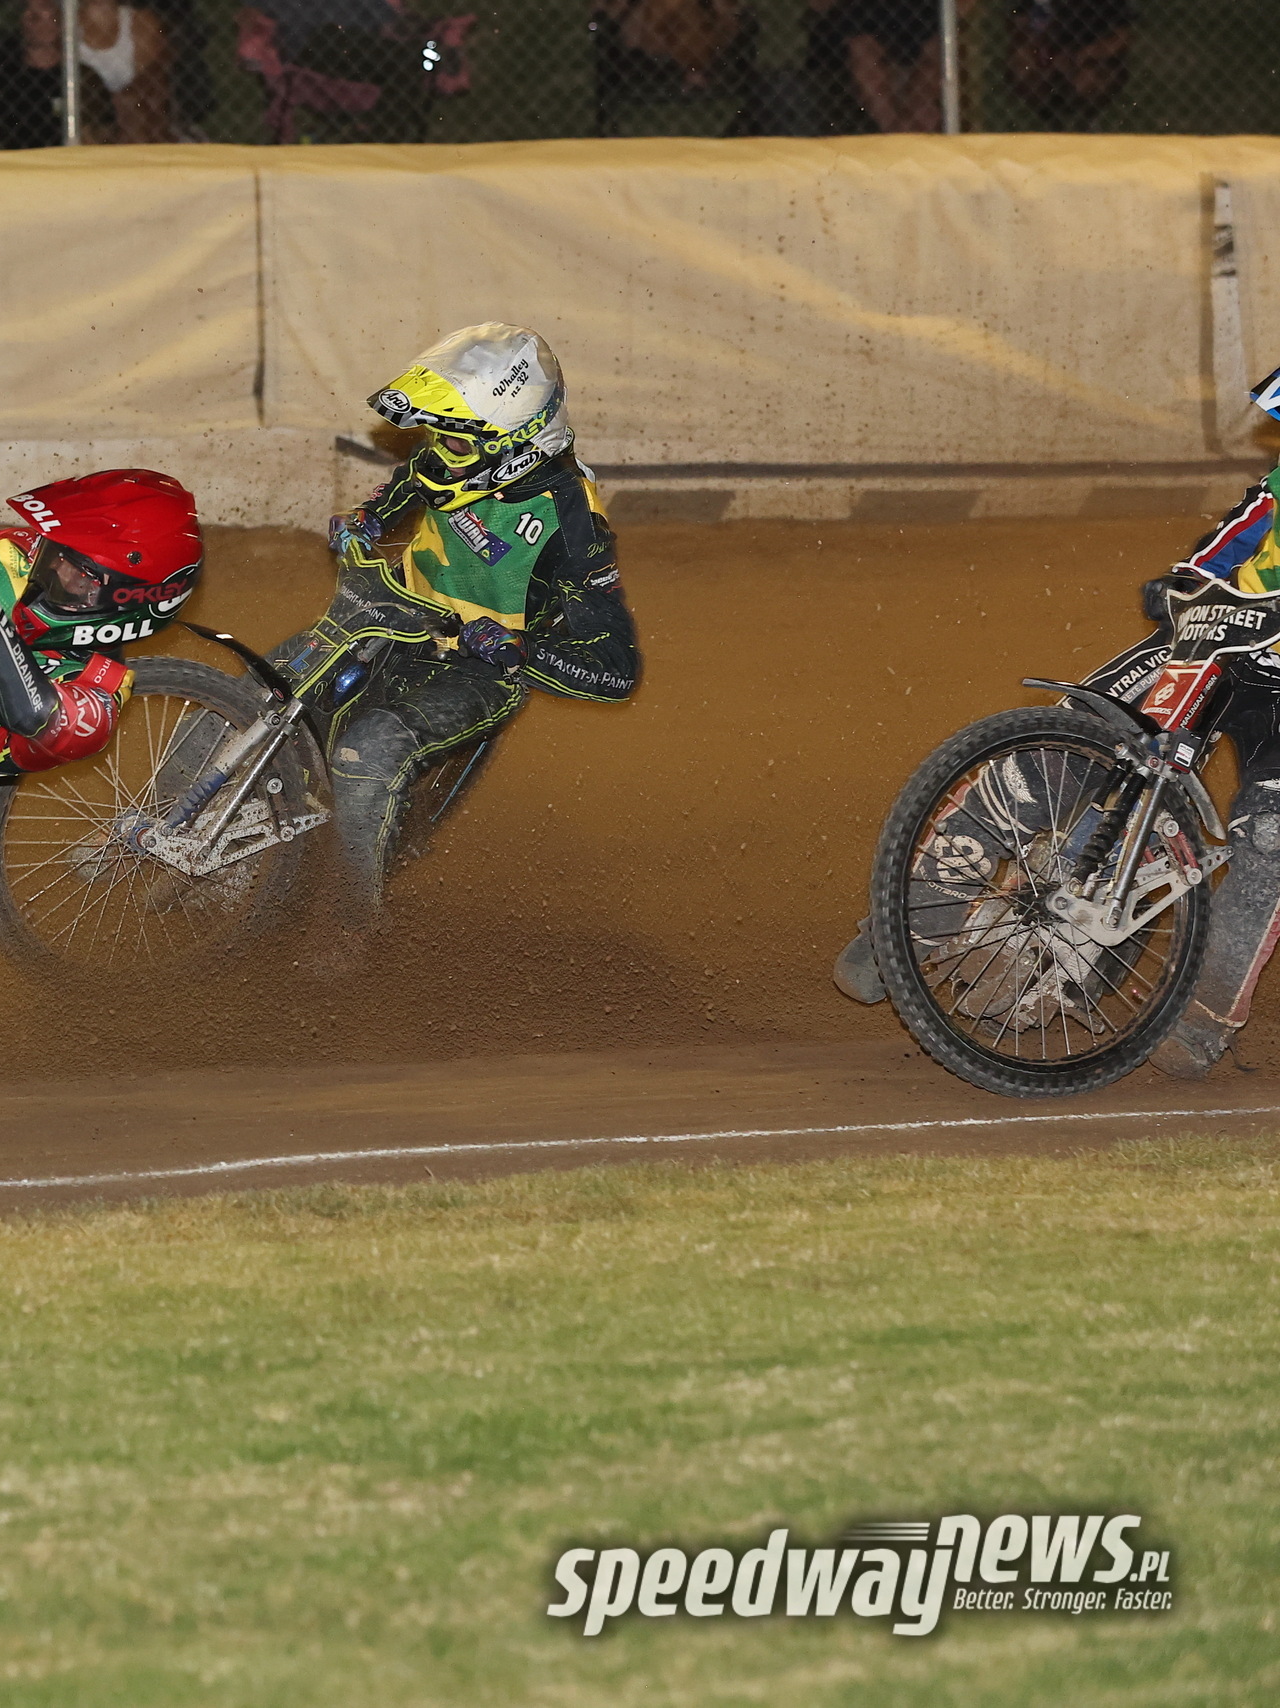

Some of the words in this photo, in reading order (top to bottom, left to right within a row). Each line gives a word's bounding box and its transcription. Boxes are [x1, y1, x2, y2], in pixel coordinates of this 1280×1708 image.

[492, 358, 529, 397] Whalley
[517, 371, 530, 390] 32
[384, 392, 408, 409] Arai
[484, 409, 548, 455] OAKLEY
[504, 453, 535, 476] Arai
[12, 494, 61, 532] BOLL
[516, 513, 543, 544] 10
[113, 580, 186, 603] OAKLEY
[1208, 604, 1266, 630] STREET
[72, 619, 153, 645] BOLL
[12, 643, 44, 713] DRAINAGE
[1105, 666, 1148, 700] NTRAL
[1145, 649, 1170, 670] VIC
